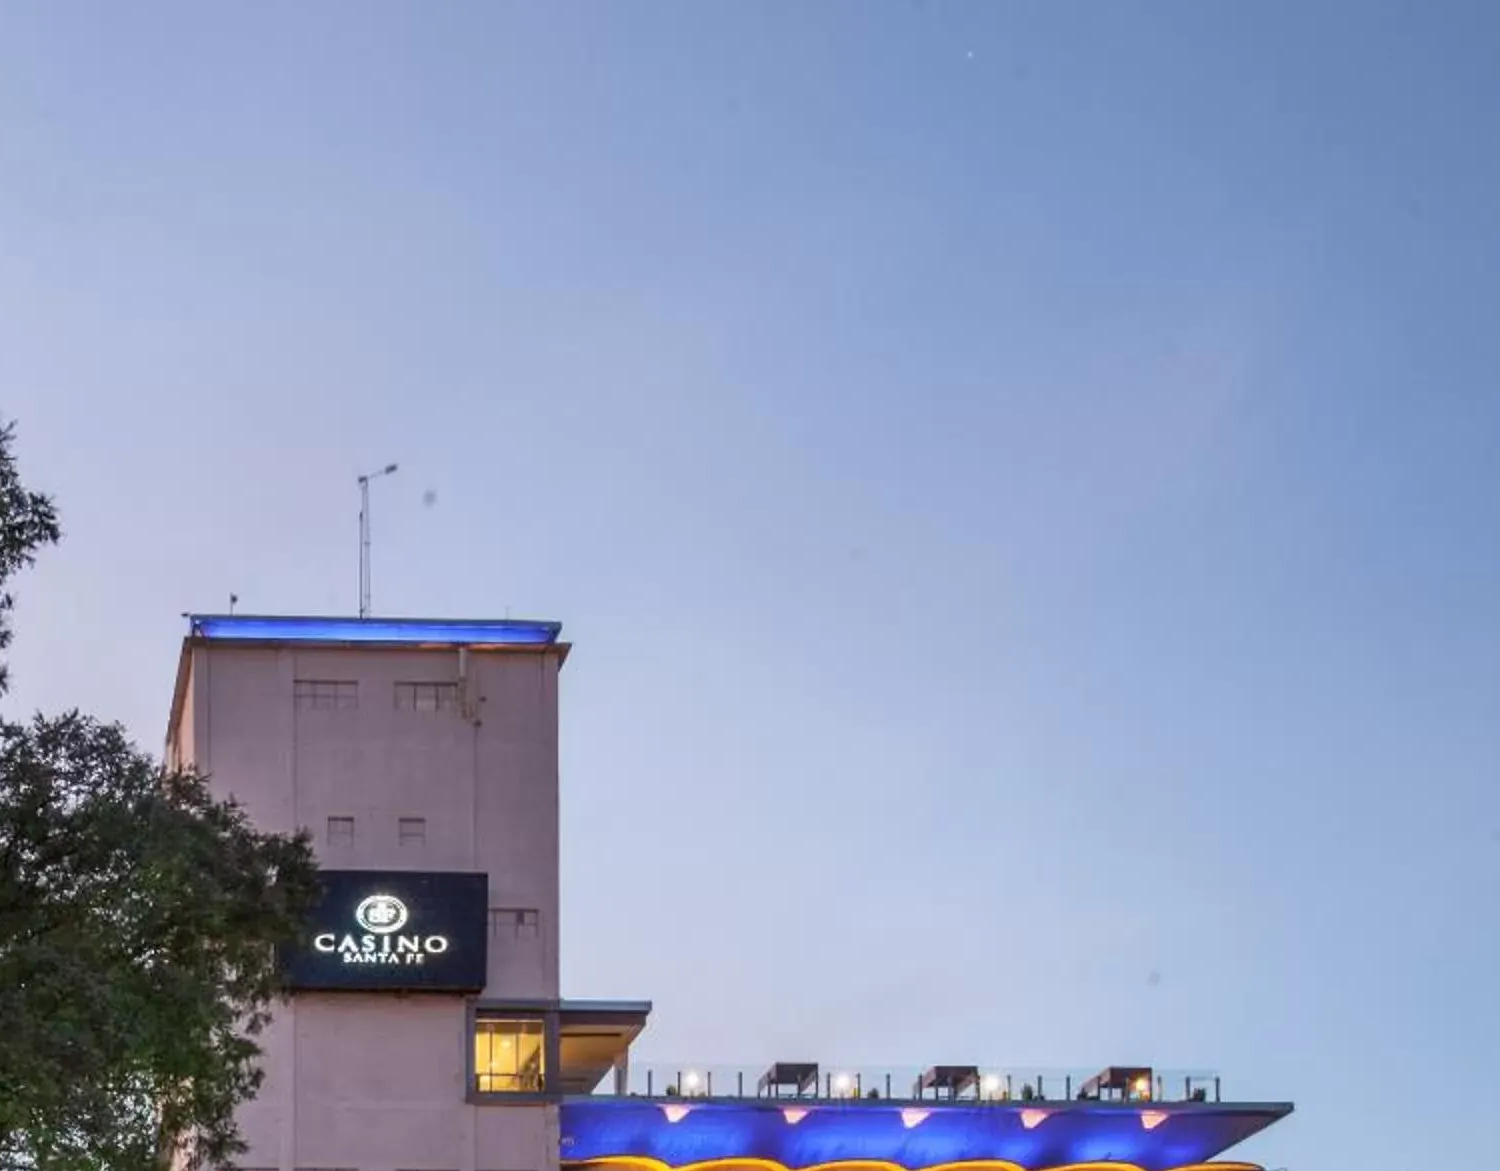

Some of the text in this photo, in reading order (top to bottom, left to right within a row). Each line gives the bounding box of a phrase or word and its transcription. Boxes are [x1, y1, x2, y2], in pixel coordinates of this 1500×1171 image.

[314, 933, 448, 953] CASINO
[343, 952, 426, 964] SANTA FE
